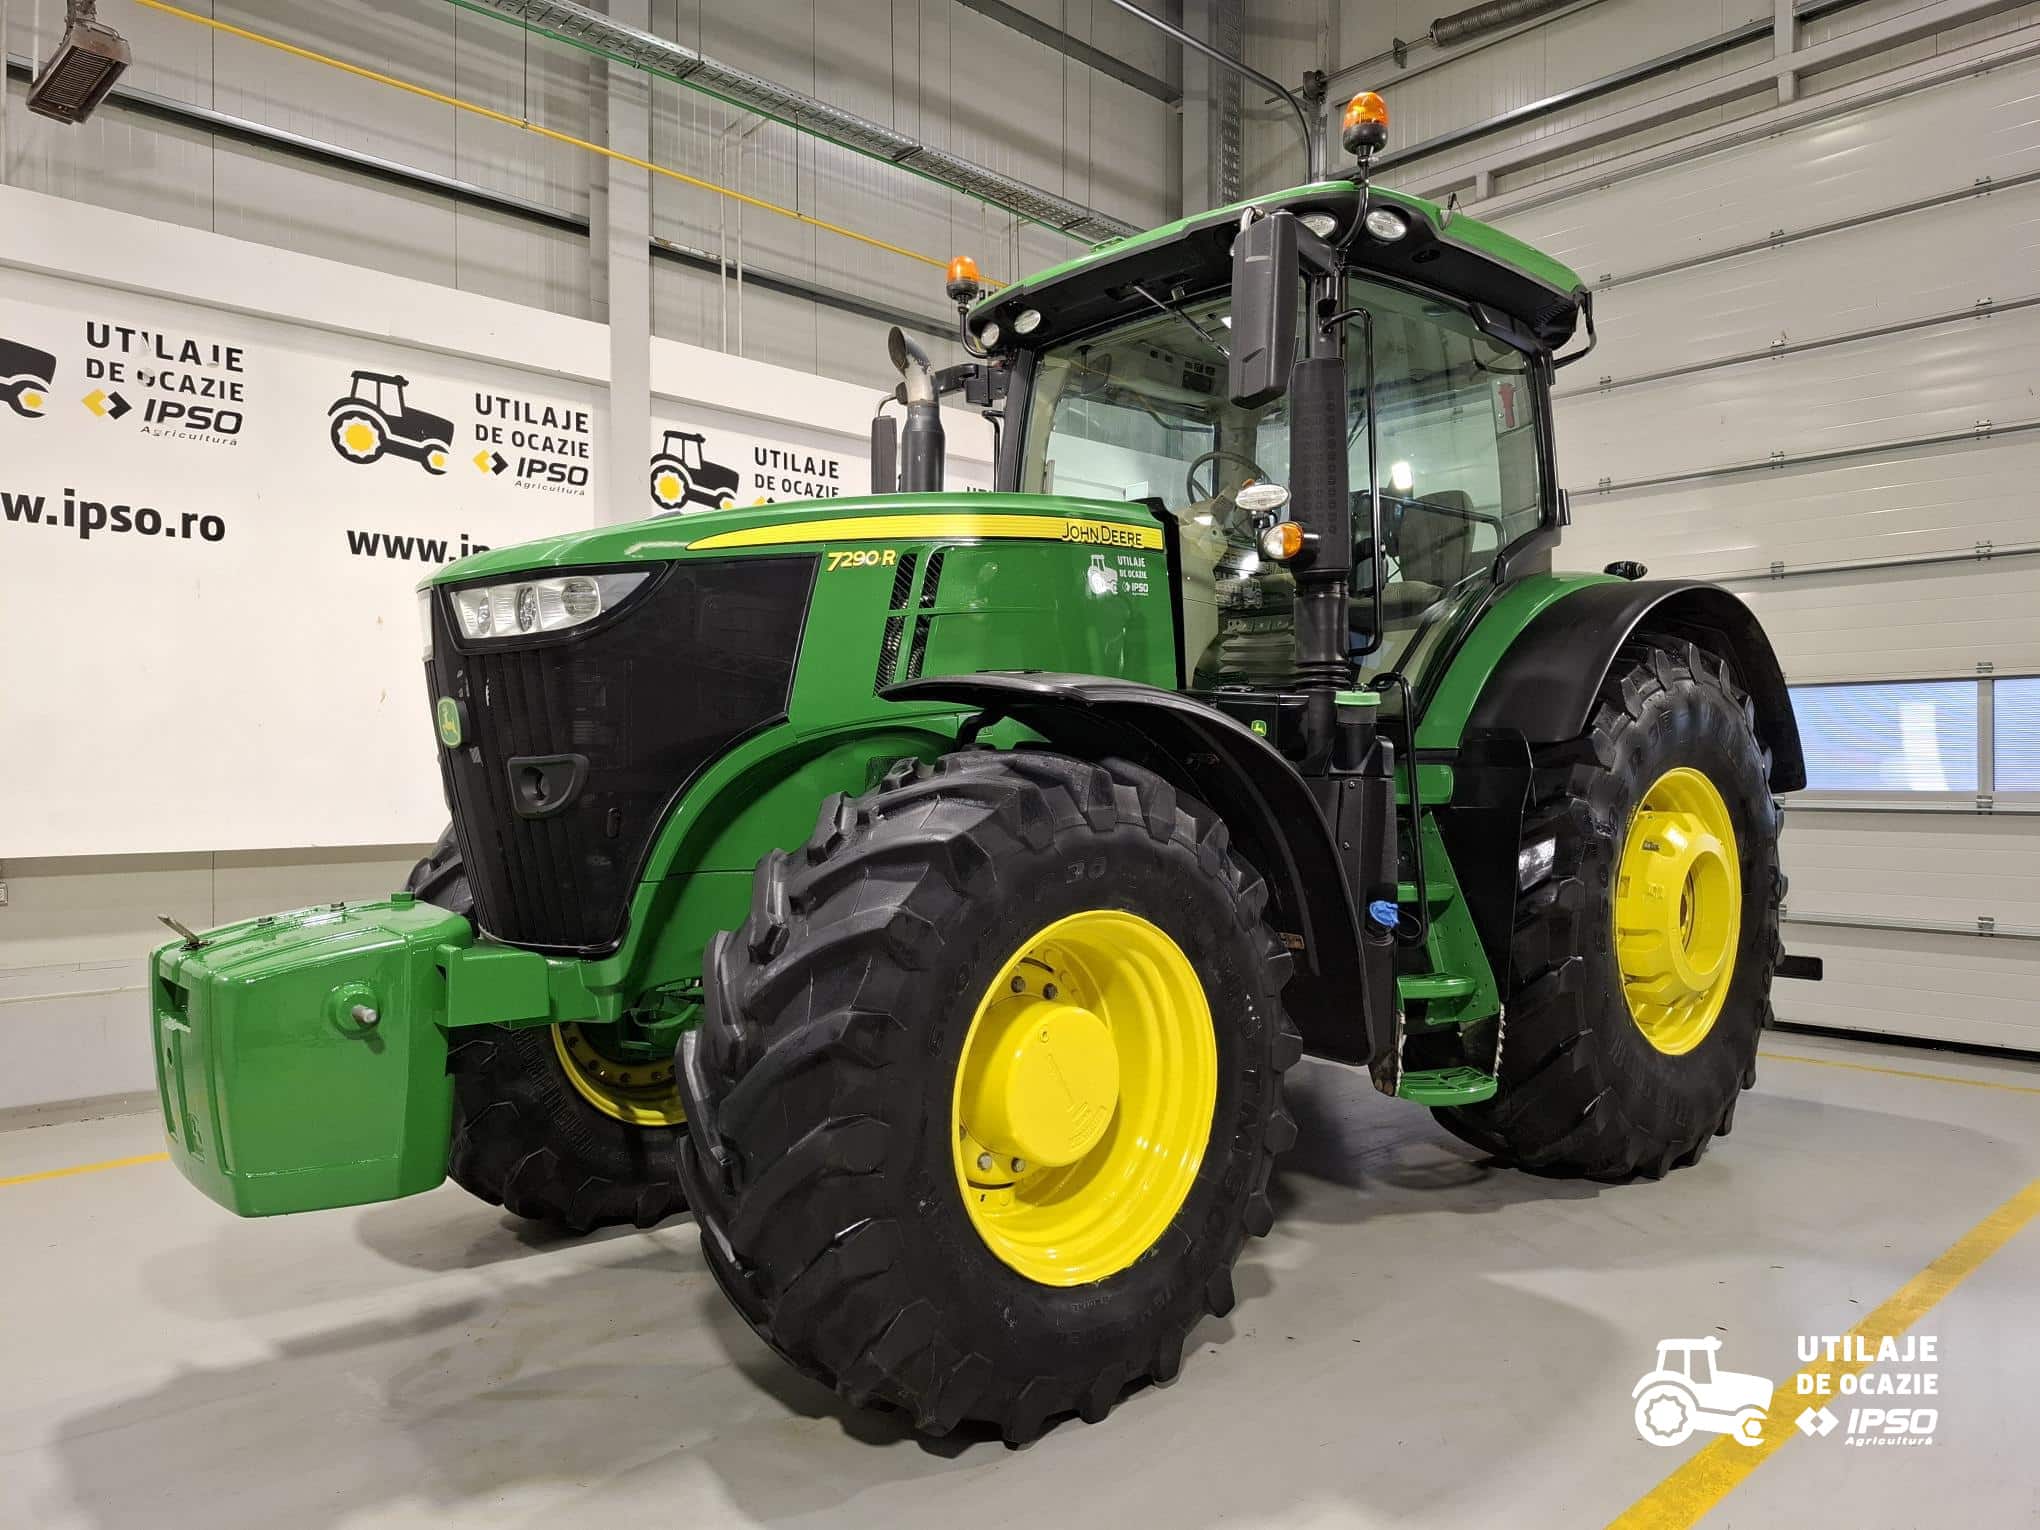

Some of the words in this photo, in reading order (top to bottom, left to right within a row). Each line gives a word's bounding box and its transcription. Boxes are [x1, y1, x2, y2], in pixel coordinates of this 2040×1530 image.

[86, 358, 125, 383] DE
[144, 399, 243, 435] IPSO
[475, 393, 589, 434] UTILAJE
[475, 424, 503, 444] DE
[511, 430, 590, 459] OCAZIE
[516, 457, 588, 486] IPSO
[755, 447, 839, 479] UTILAJE
[755, 474, 775, 490] DE
[782, 478, 839, 499] OCAZIE
[1131, 582, 1149, 593] IPSO
